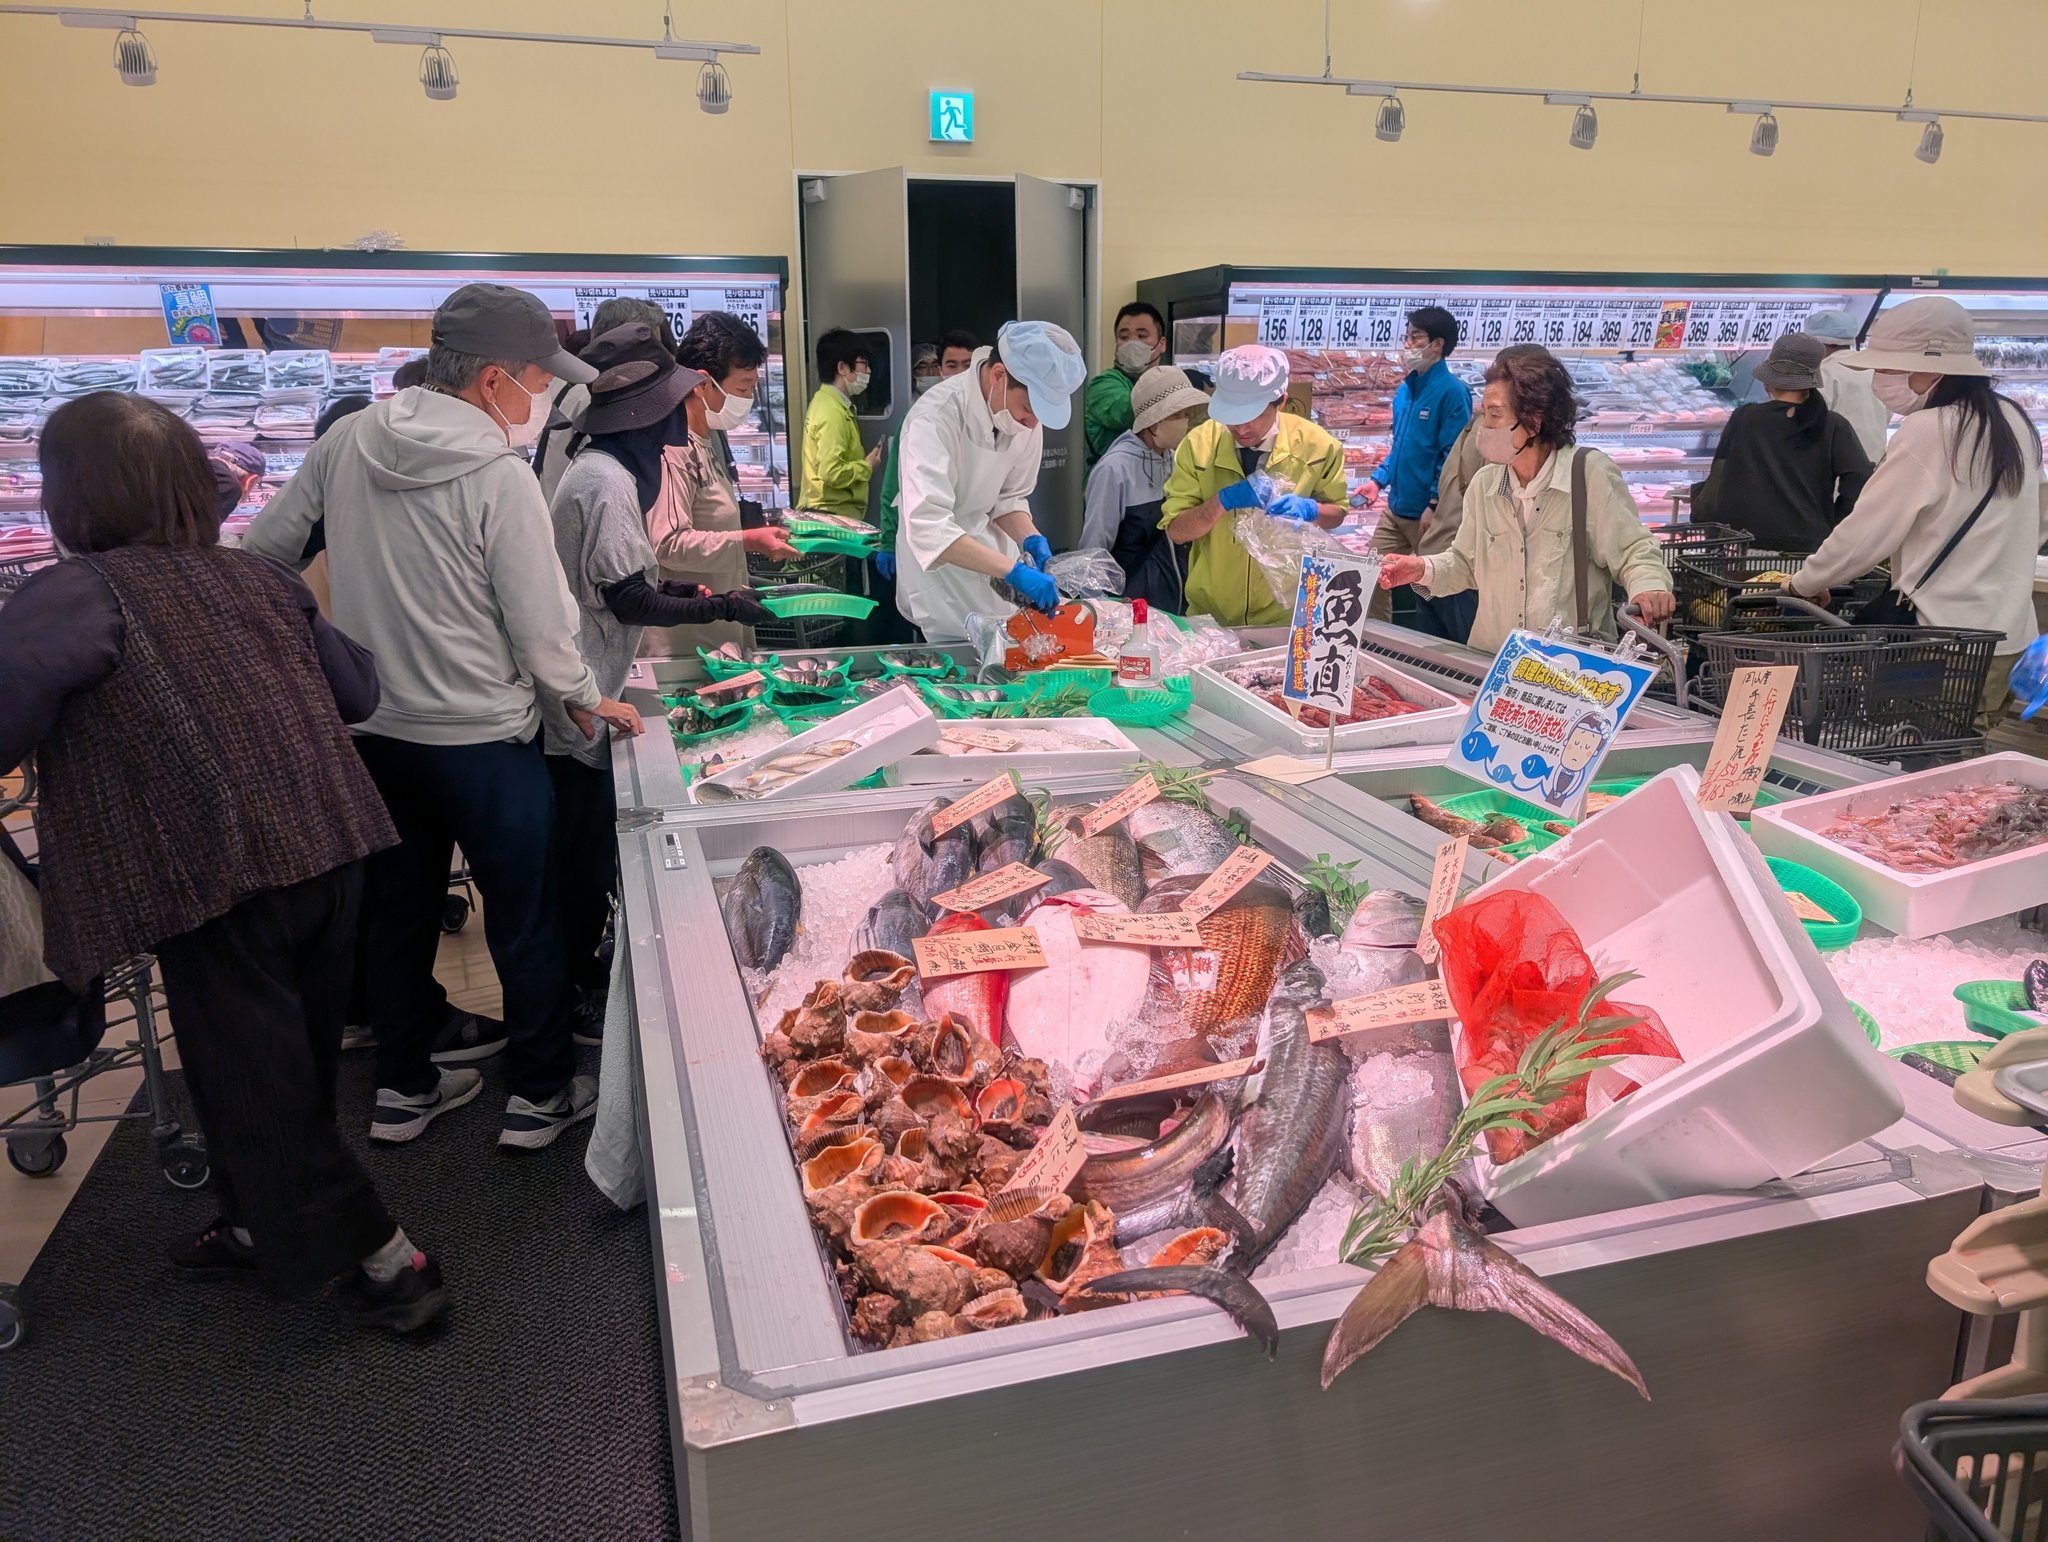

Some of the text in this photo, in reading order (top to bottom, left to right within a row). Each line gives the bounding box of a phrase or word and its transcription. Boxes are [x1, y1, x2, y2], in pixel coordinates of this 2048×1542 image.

[173, 290, 210, 310] 真鯛
[576, 288, 616, 297] 売り切れ御免
[649, 289, 688, 297] 売り切れ御免
[726, 290, 763, 298] 売り切れ御免
[1265, 318, 1287, 341] 156
[1301, 318, 1322, 341] 128
[1337, 319, 1358, 342] 184
[1370, 319, 1391, 342] 128
[1482, 320, 1502, 342] 128
[1513, 320, 1535, 342] 258
[1544, 320, 1564, 342] 156
[1573, 320, 1593, 342] 184
[1600, 320, 1621, 342] 369
[1631, 321, 1652, 342] 276
[1688, 321, 1709, 342] 369
[1718, 321, 1738, 342] 369
[1752, 321, 1772, 342] 462
[1512, 657, 1622, 706] 調理はいたしかねます
[1489, 698, 1569, 741] 調理を承っておりません
